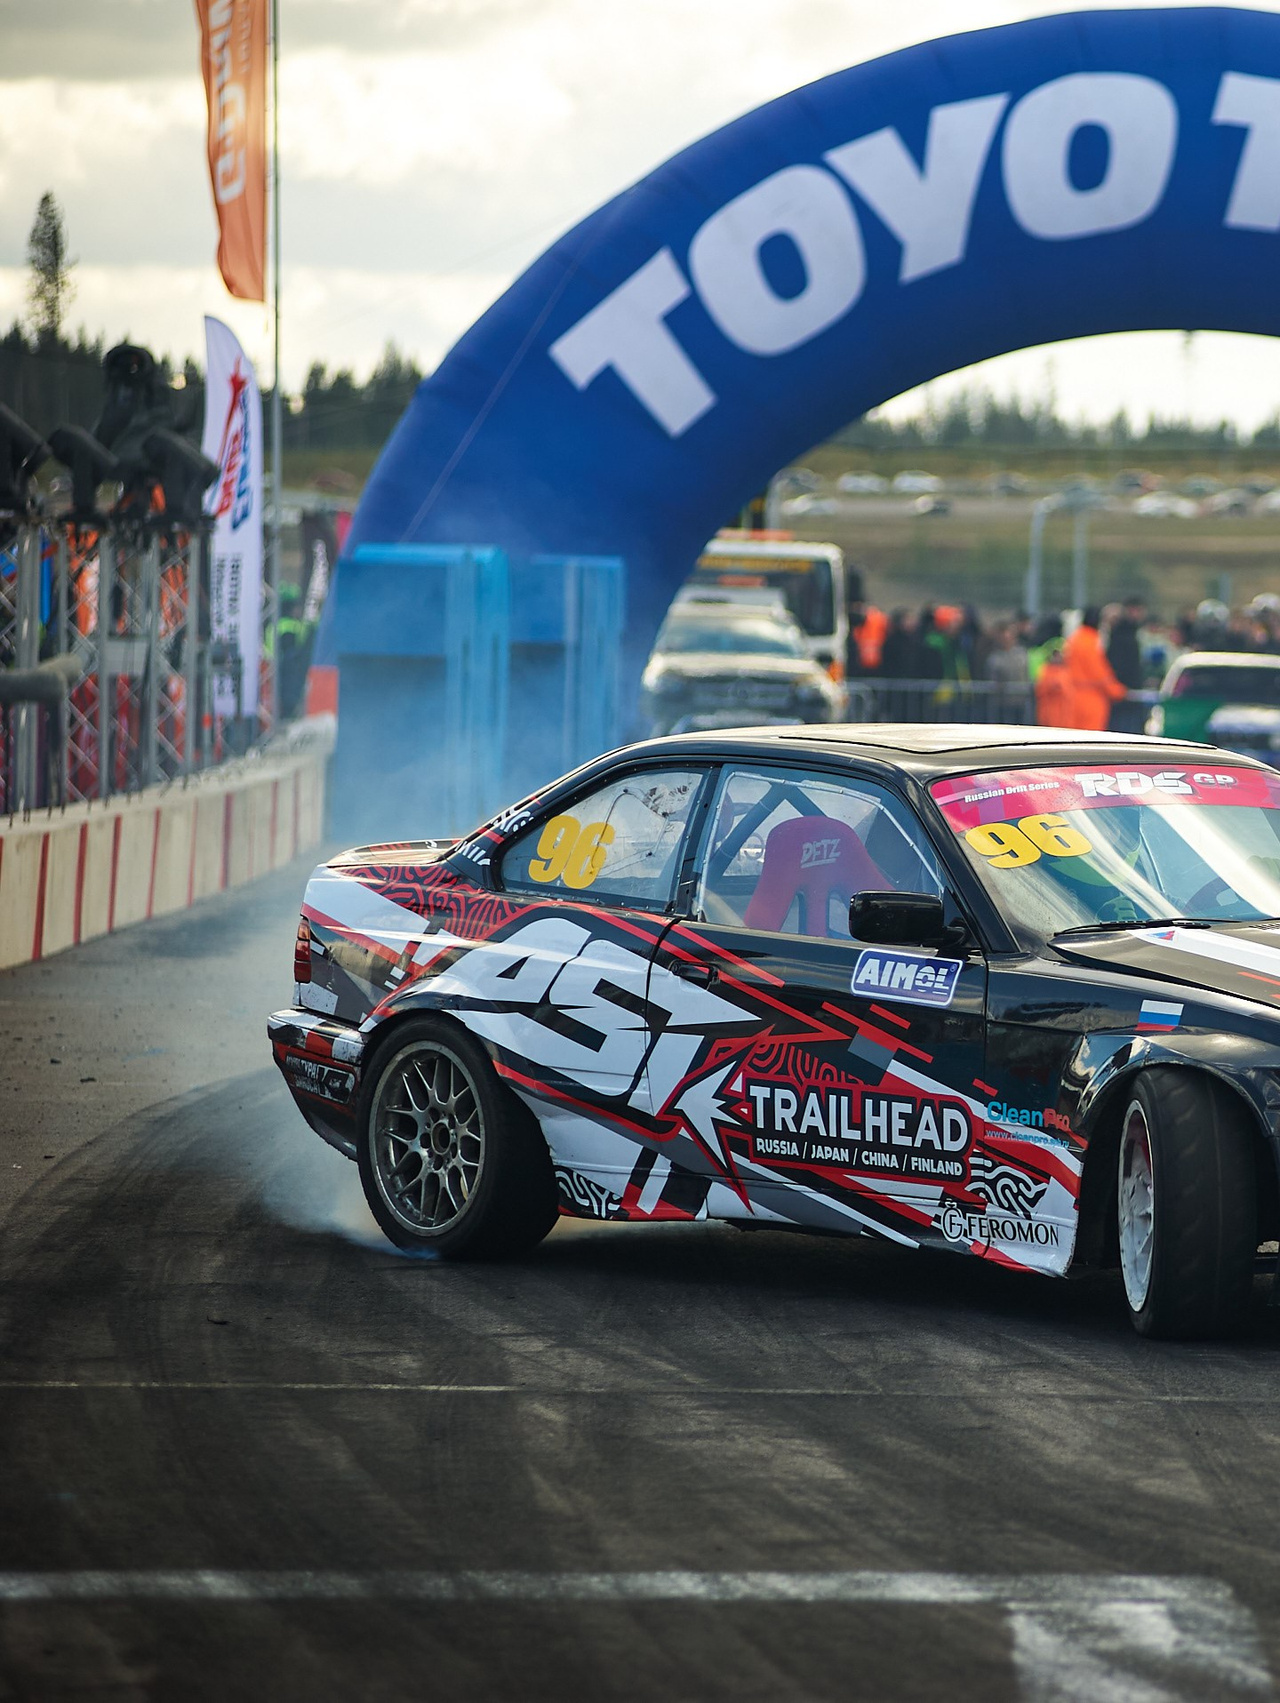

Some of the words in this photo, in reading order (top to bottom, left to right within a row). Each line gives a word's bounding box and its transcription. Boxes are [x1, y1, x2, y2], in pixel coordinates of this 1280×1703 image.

[549, 71, 1179, 438] TOYO
[964, 788, 1005, 803] Russian
[1006, 783, 1028, 795] Drift
[1028, 780, 1060, 792] Series
[1075, 771, 1193, 798] RDS
[1193, 773, 1237, 789] GP
[529, 815, 615, 889] 96
[965, 814, 1092, 869] 96
[856, 958, 950, 996] AIMOL
[749, 1085, 969, 1152] TRAILHEAD
[987, 1101, 1070, 1132] CleanPro
[756, 1137, 799, 1156] RUSSIA
[811, 1144, 849, 1163] JAPAN
[861, 1150, 899, 1169] CHINA
[911, 1156, 963, 1176] FINLAND
[967, 1215, 1059, 1247] FEROMON
